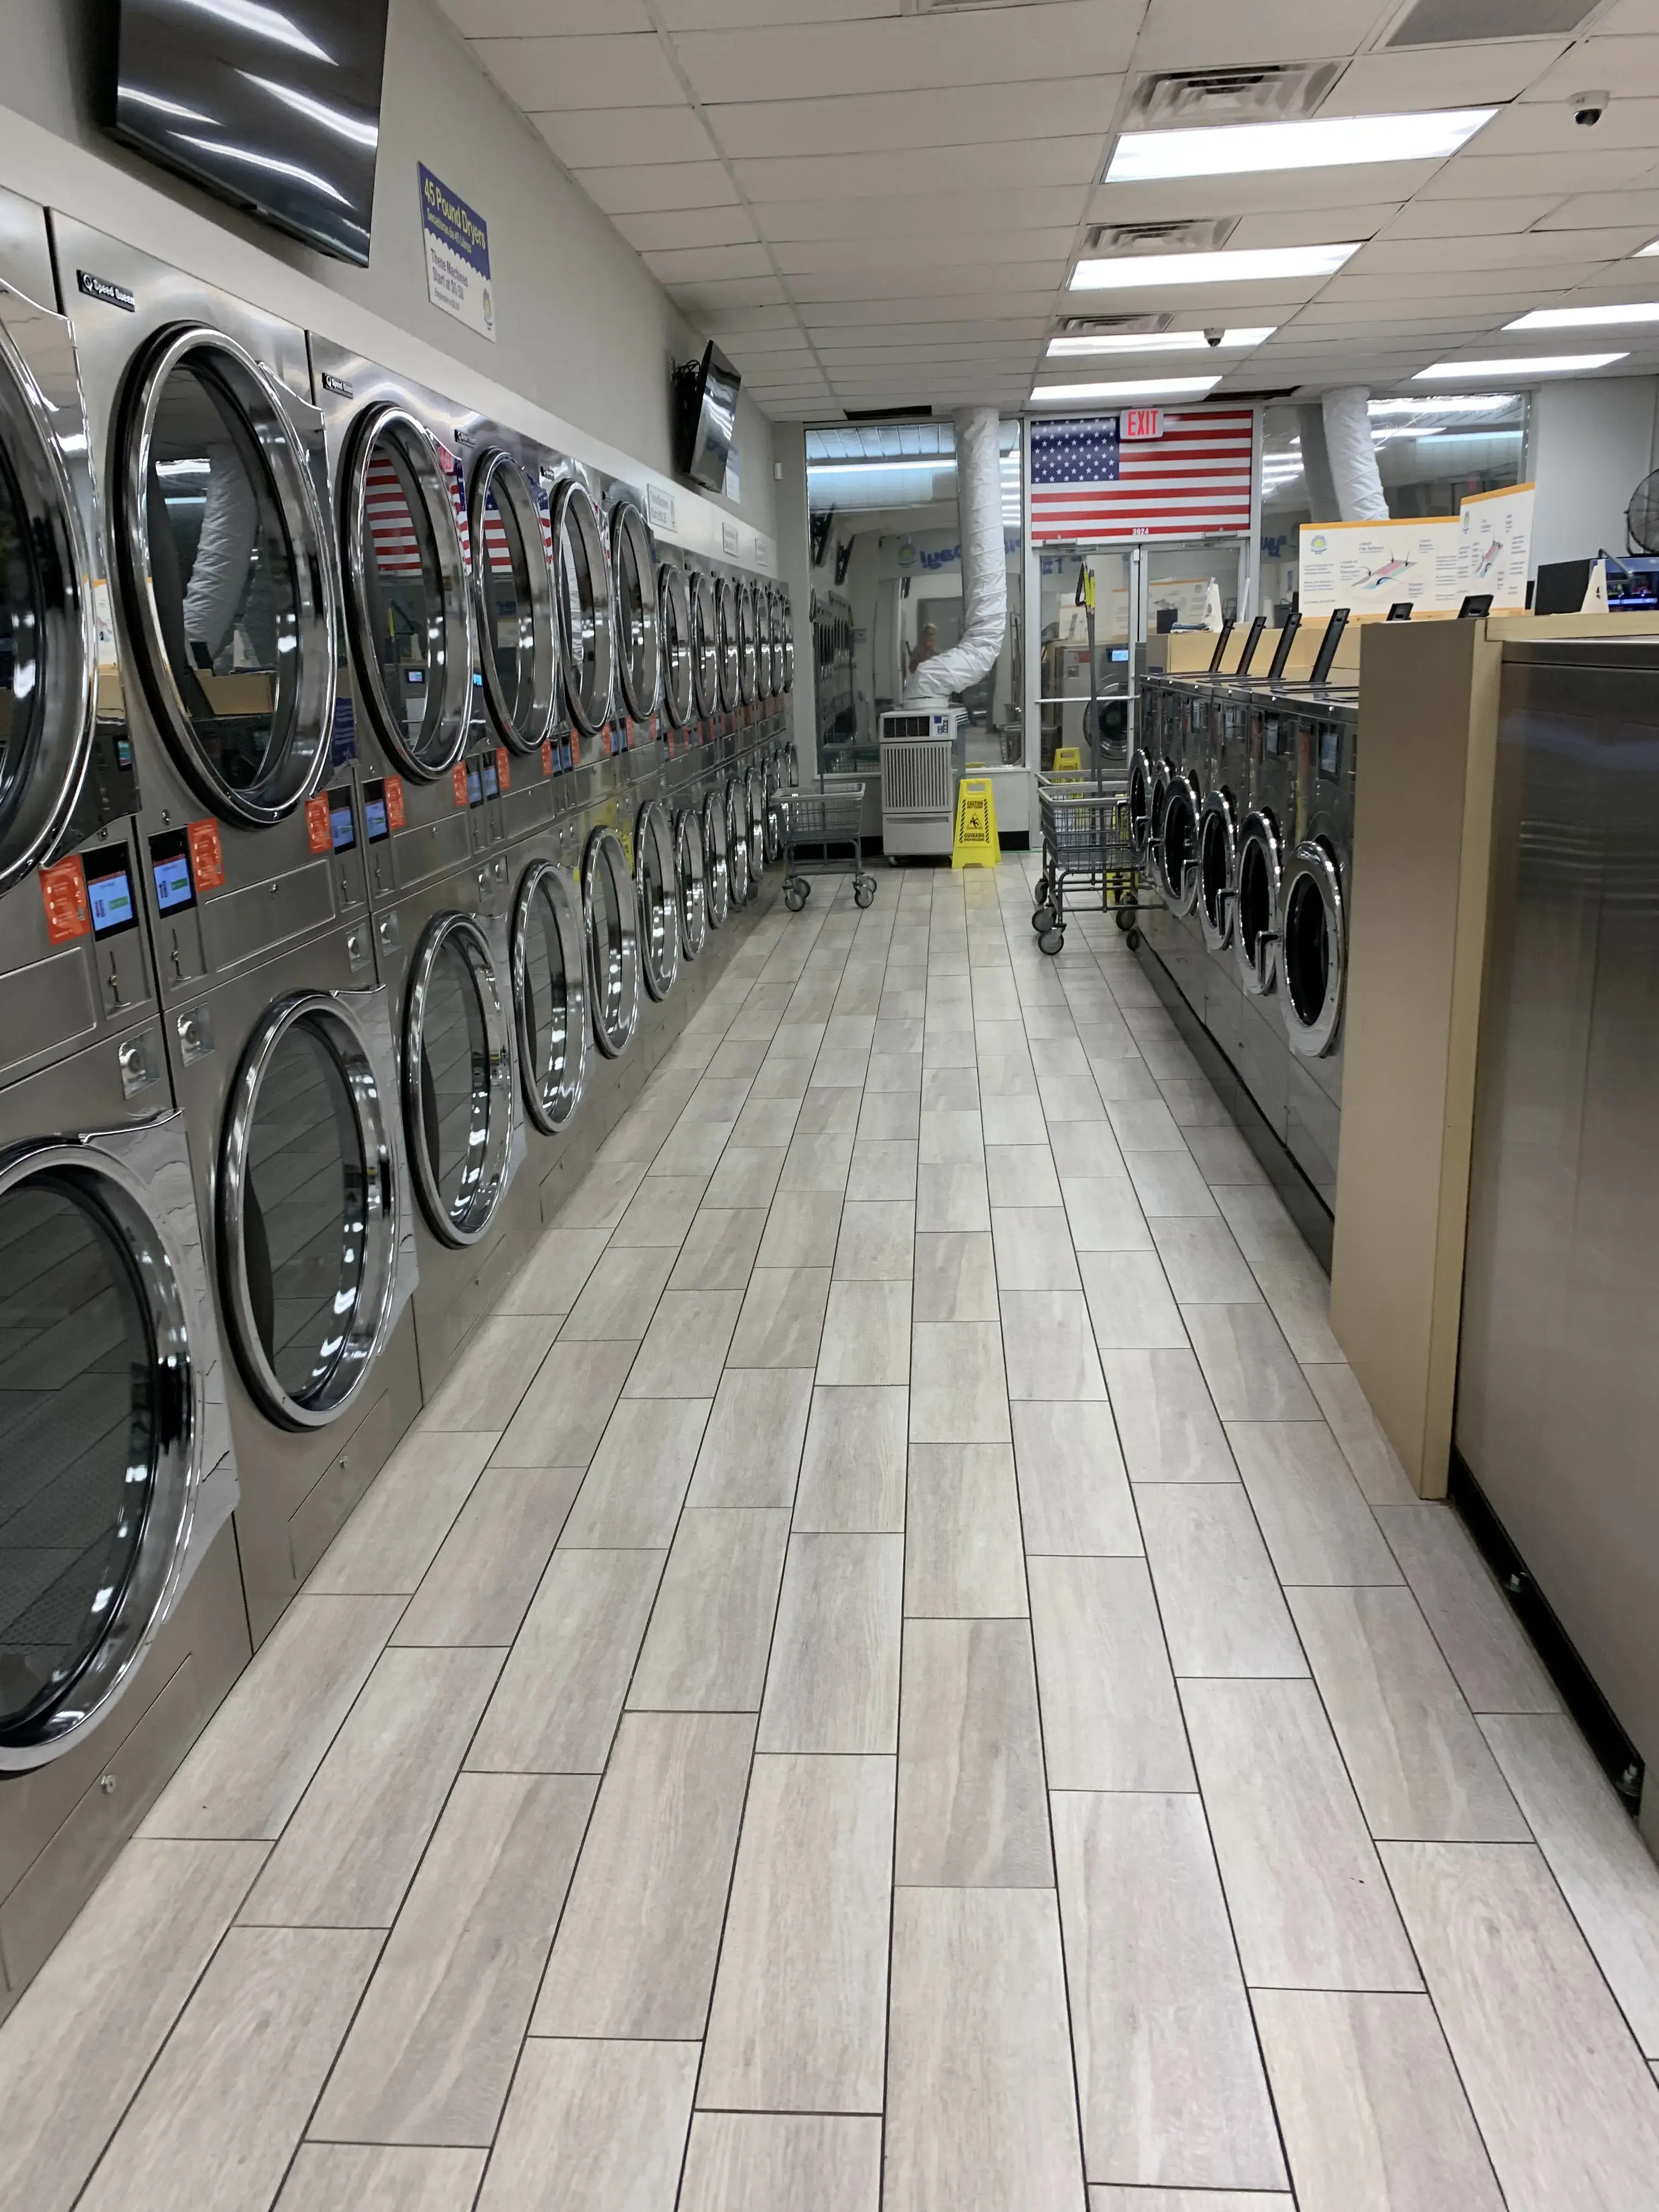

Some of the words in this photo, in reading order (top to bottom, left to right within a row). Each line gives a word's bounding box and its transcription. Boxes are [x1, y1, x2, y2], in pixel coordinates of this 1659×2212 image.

[425, 178, 435, 206] 45
[436, 187, 461, 229] Pound
[461, 210, 486, 250] Dryers
[93, 279, 114, 297] Speed
[1127, 410, 1158, 436] EXIT
[1132, 527, 1149, 535] 3924
